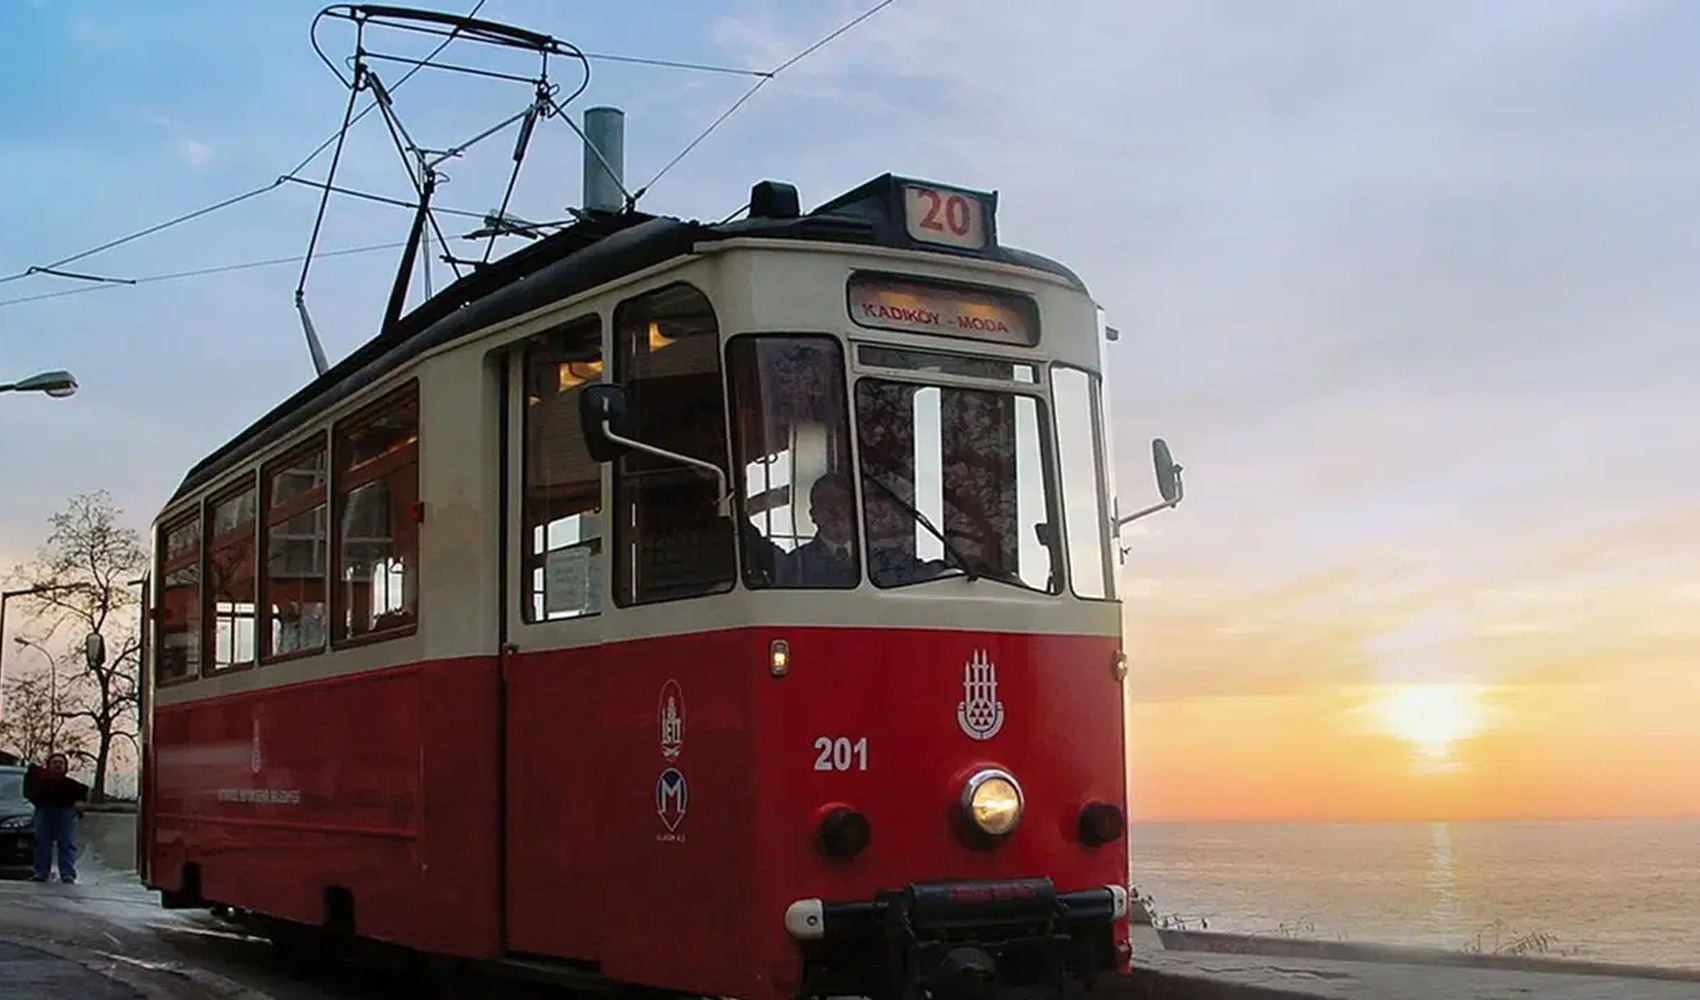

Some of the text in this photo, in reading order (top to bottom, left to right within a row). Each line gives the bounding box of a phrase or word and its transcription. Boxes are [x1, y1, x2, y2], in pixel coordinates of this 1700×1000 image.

[918, 188, 971, 236] 20
[957, 315, 1009, 333] MODA
[814, 736, 867, 771] 201
